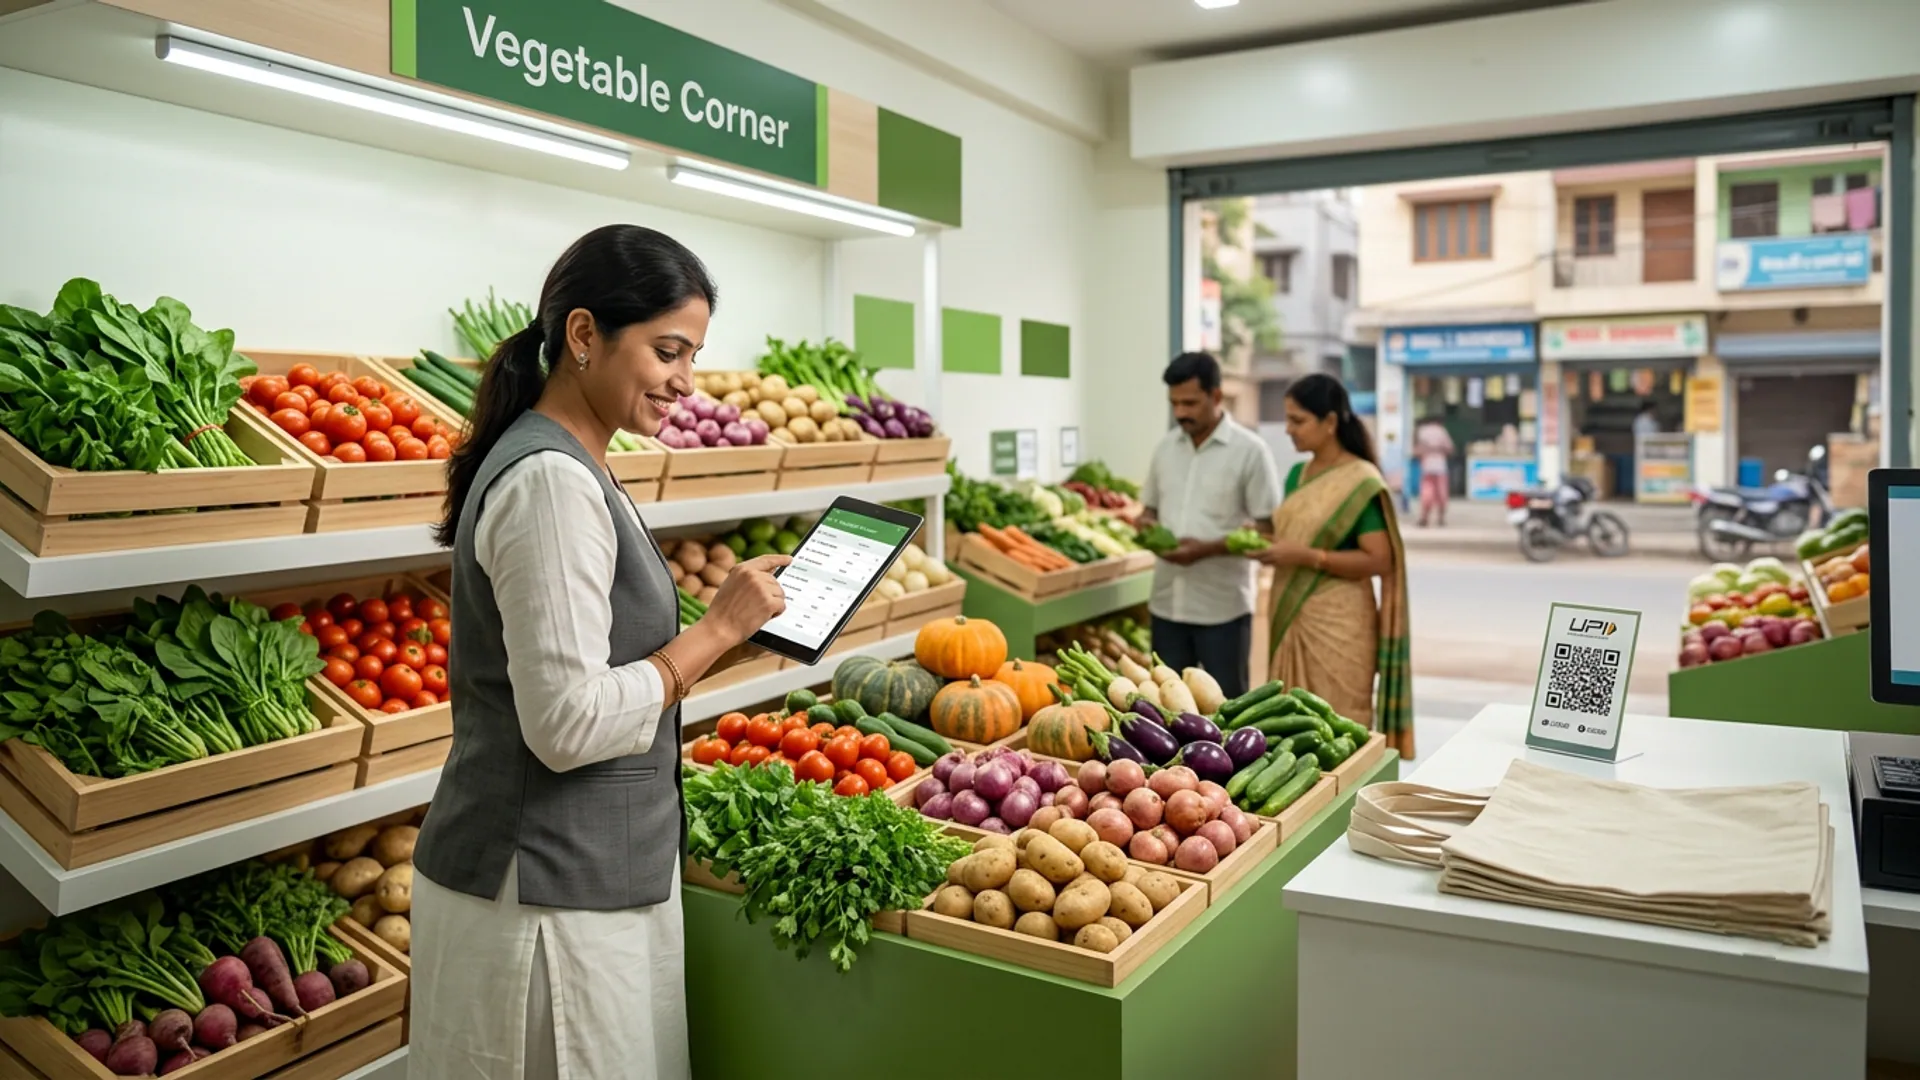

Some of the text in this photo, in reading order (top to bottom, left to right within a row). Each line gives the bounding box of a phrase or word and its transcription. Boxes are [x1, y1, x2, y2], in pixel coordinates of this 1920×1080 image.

[462, 5, 789, 148] Vegetable Corner
[1569, 617, 1610, 636] UPI
